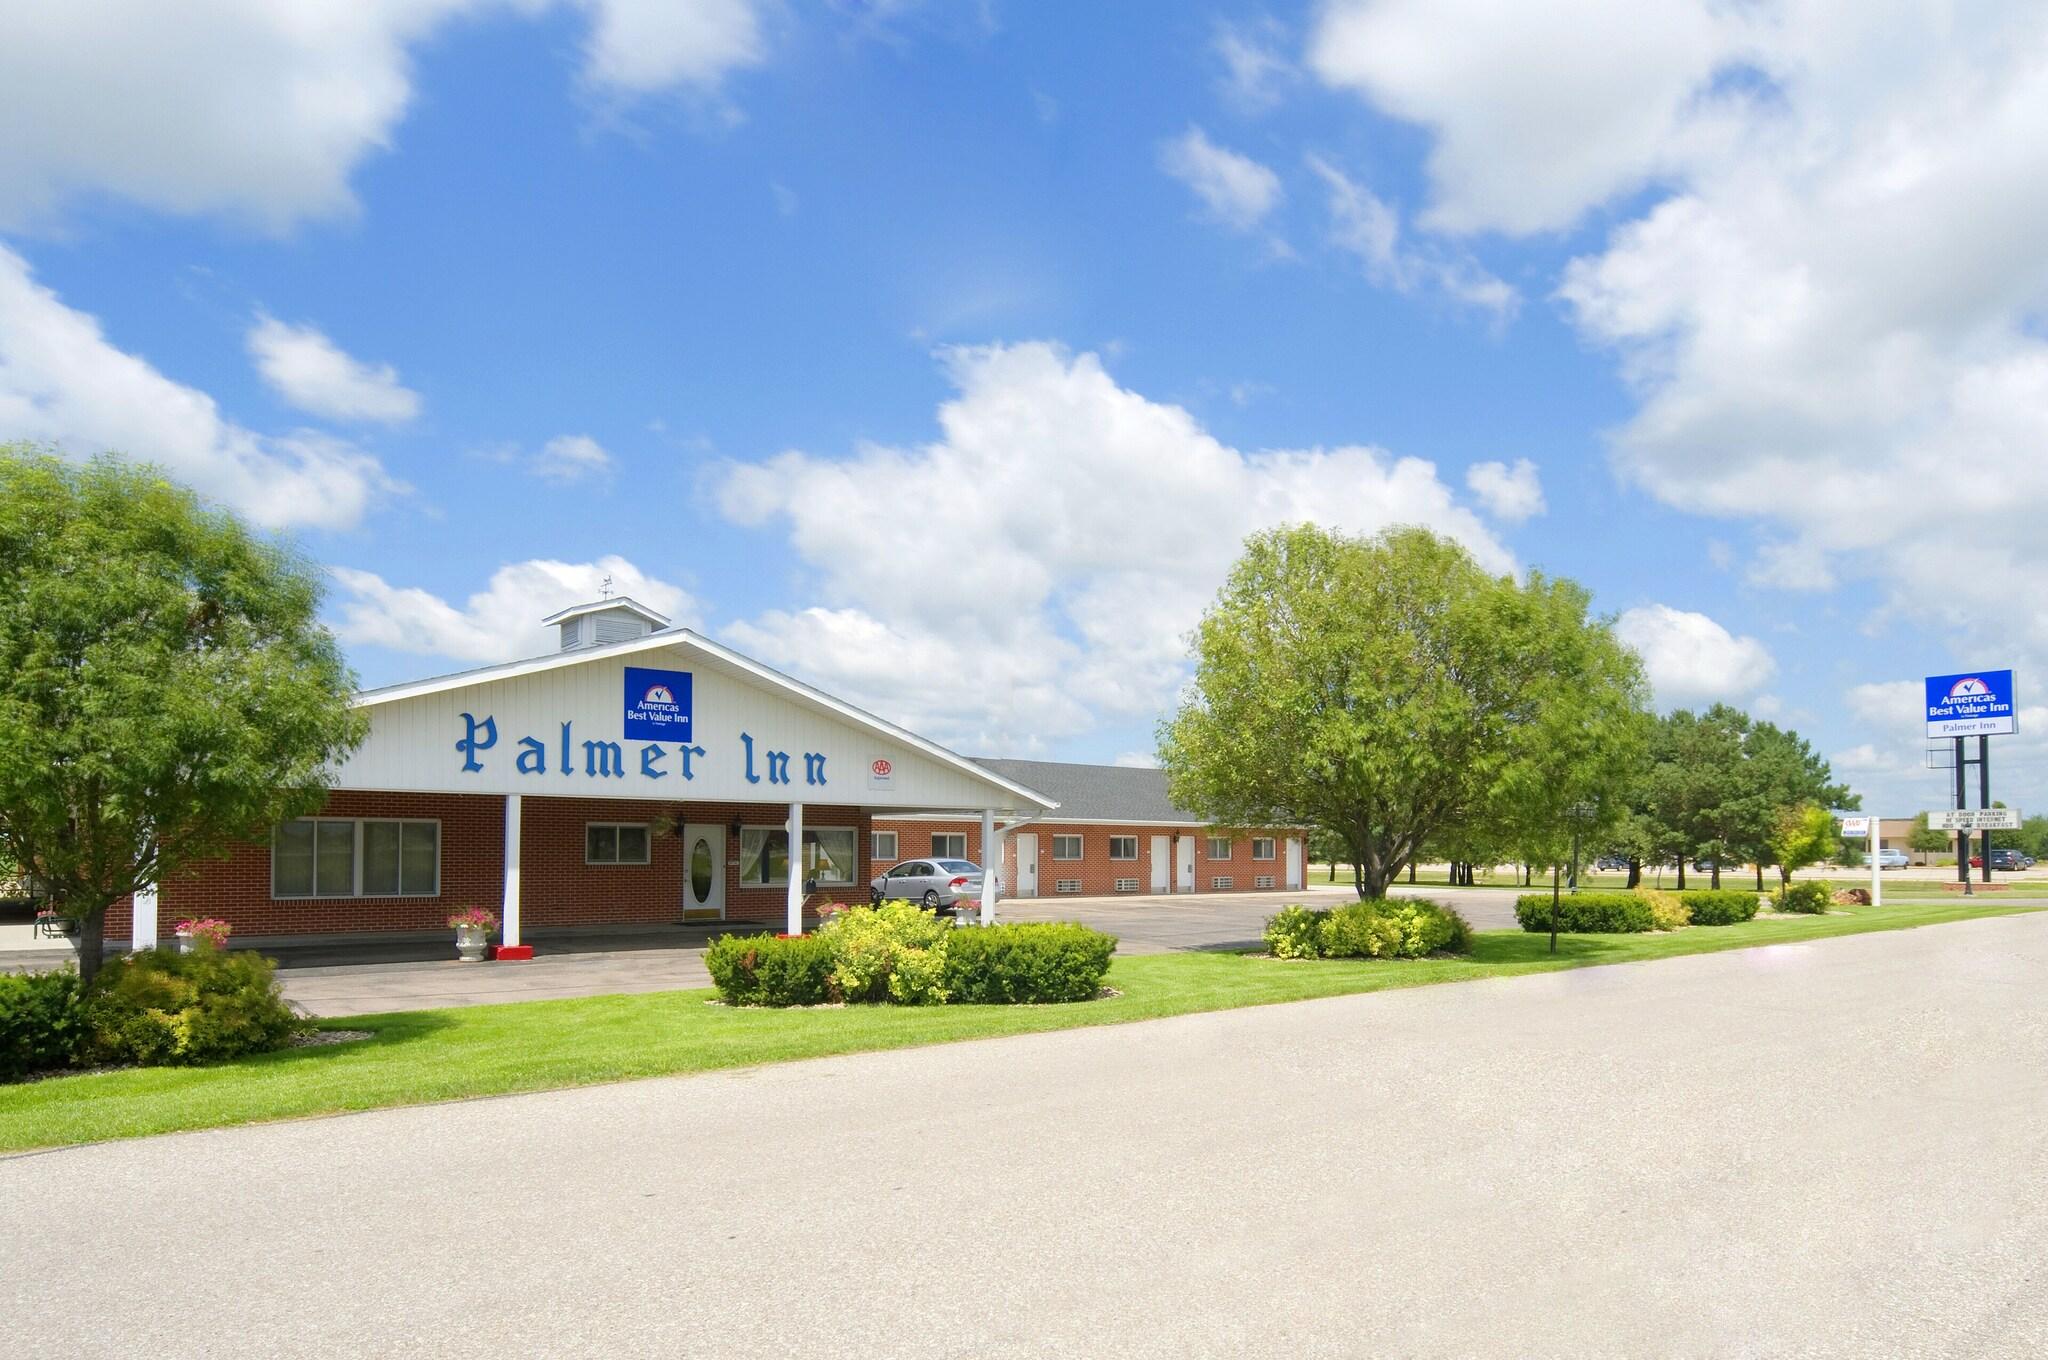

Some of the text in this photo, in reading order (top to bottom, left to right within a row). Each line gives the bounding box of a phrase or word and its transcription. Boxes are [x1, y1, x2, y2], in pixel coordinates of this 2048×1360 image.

[637, 700, 680, 712] Americas
[1941, 694, 1997, 705] Americas
[1929, 706, 1954, 716] Best
[1956, 703, 1988, 714] Value
[1990, 702, 2009, 712] Inn
[627, 709, 689, 723] Best Value Inn
[1943, 721, 1996, 732] Palmer Inn
[455, 712, 828, 786] Palmer Inn
[873, 761, 890, 774] AAA
